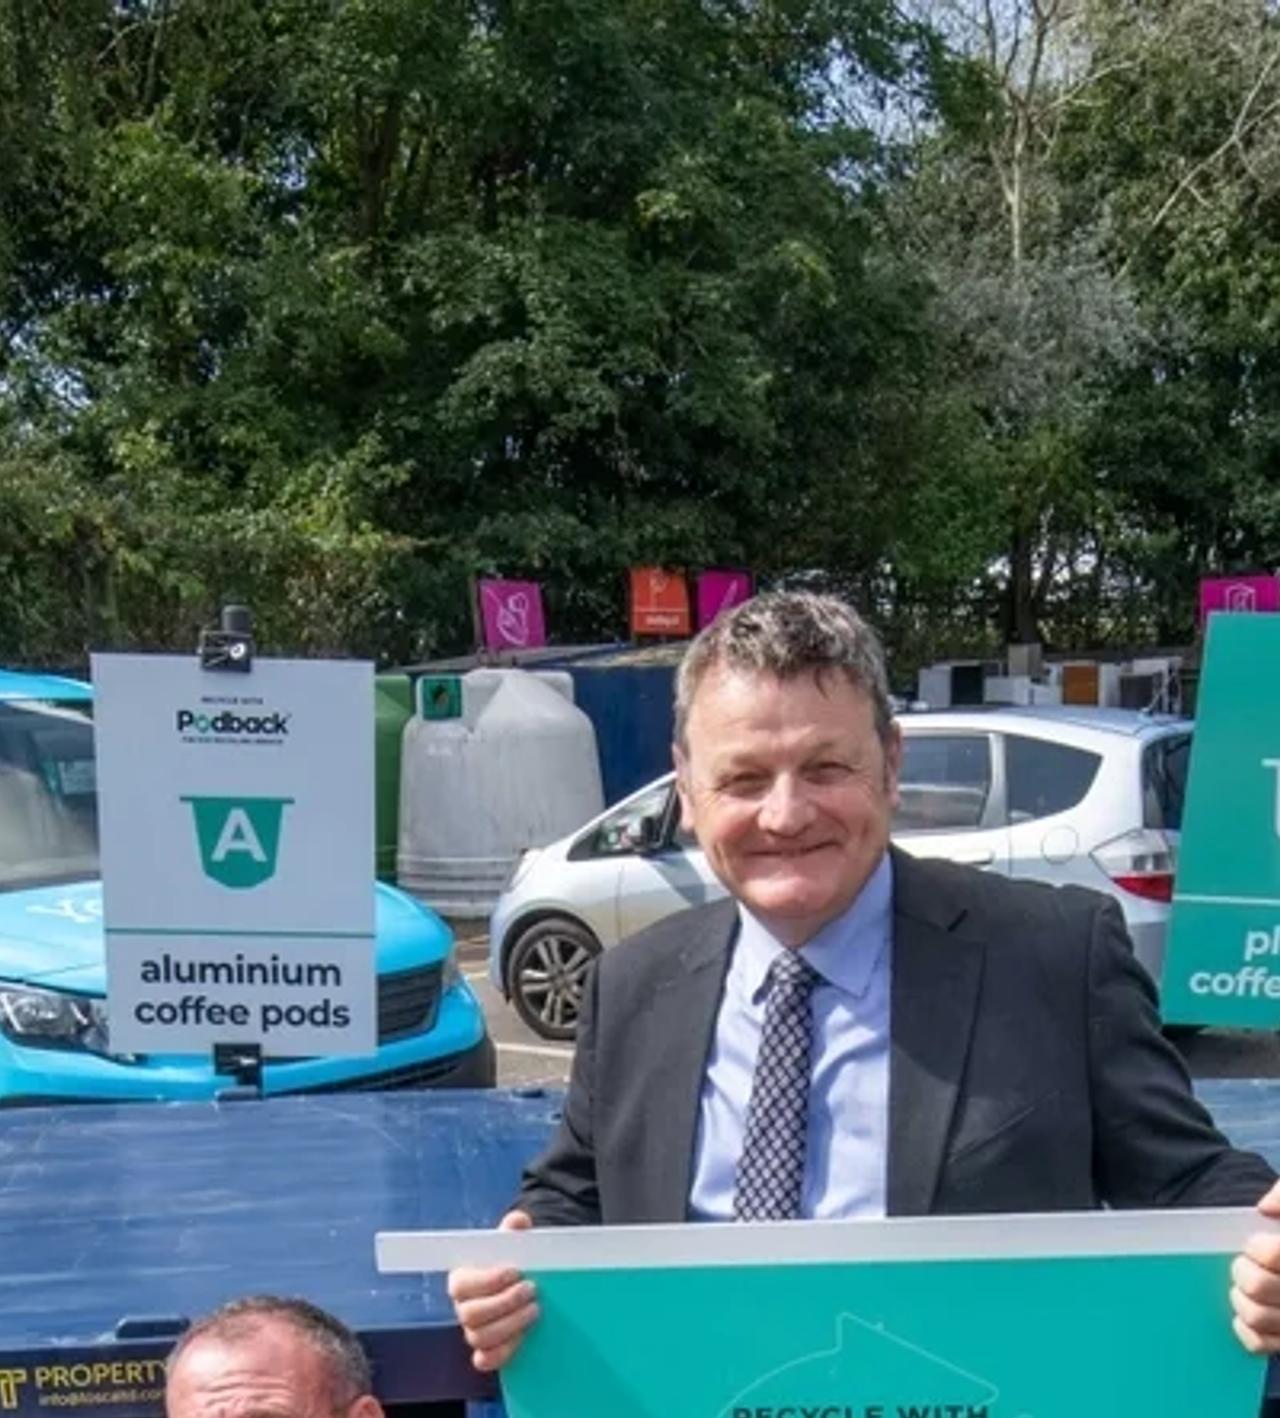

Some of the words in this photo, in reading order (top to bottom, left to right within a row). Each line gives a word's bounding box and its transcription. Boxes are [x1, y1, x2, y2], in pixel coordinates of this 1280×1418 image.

[211, 806, 268, 862] A
[140, 953, 342, 987] aluminium
[134, 995, 251, 1025] coffee
[261, 998, 352, 1033] pods
